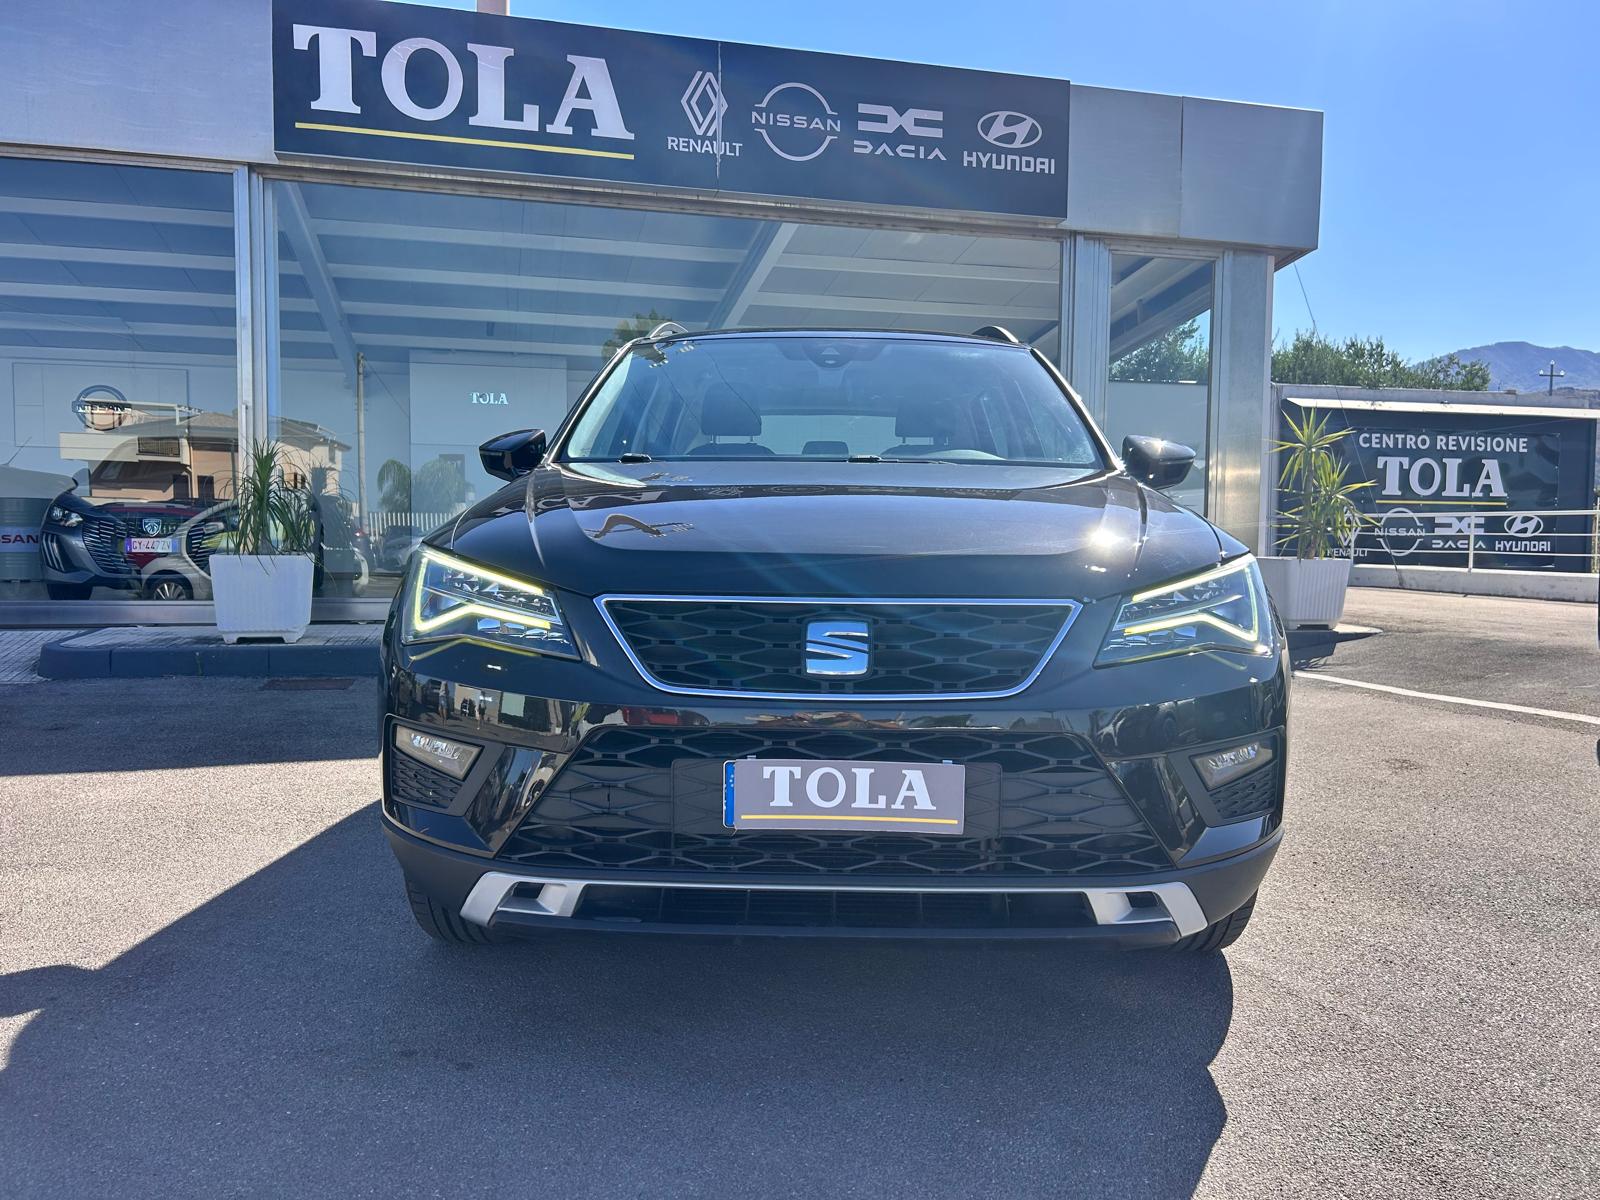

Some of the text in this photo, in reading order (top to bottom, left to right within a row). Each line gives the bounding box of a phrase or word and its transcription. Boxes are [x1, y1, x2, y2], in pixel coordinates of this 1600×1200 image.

[292, 23, 635, 140] TOLA
[751, 111, 841, 132] NISSAN
[667, 136, 743, 158] RENAULT
[853, 140, 947, 161] DACIA
[963, 150, 1055, 175] HYUNDAI
[468, 391, 509, 405] TOLA
[1358, 432, 1528, 453] CENTRO REVISIONE
[1377, 456, 1508, 498] TOLA
[1374, 527, 1425, 537] NISSAN
[1431, 539, 1486, 549] DACA
[1495, 540, 1551, 552] HYUNDAI
[763, 766, 937, 811] TOLA
